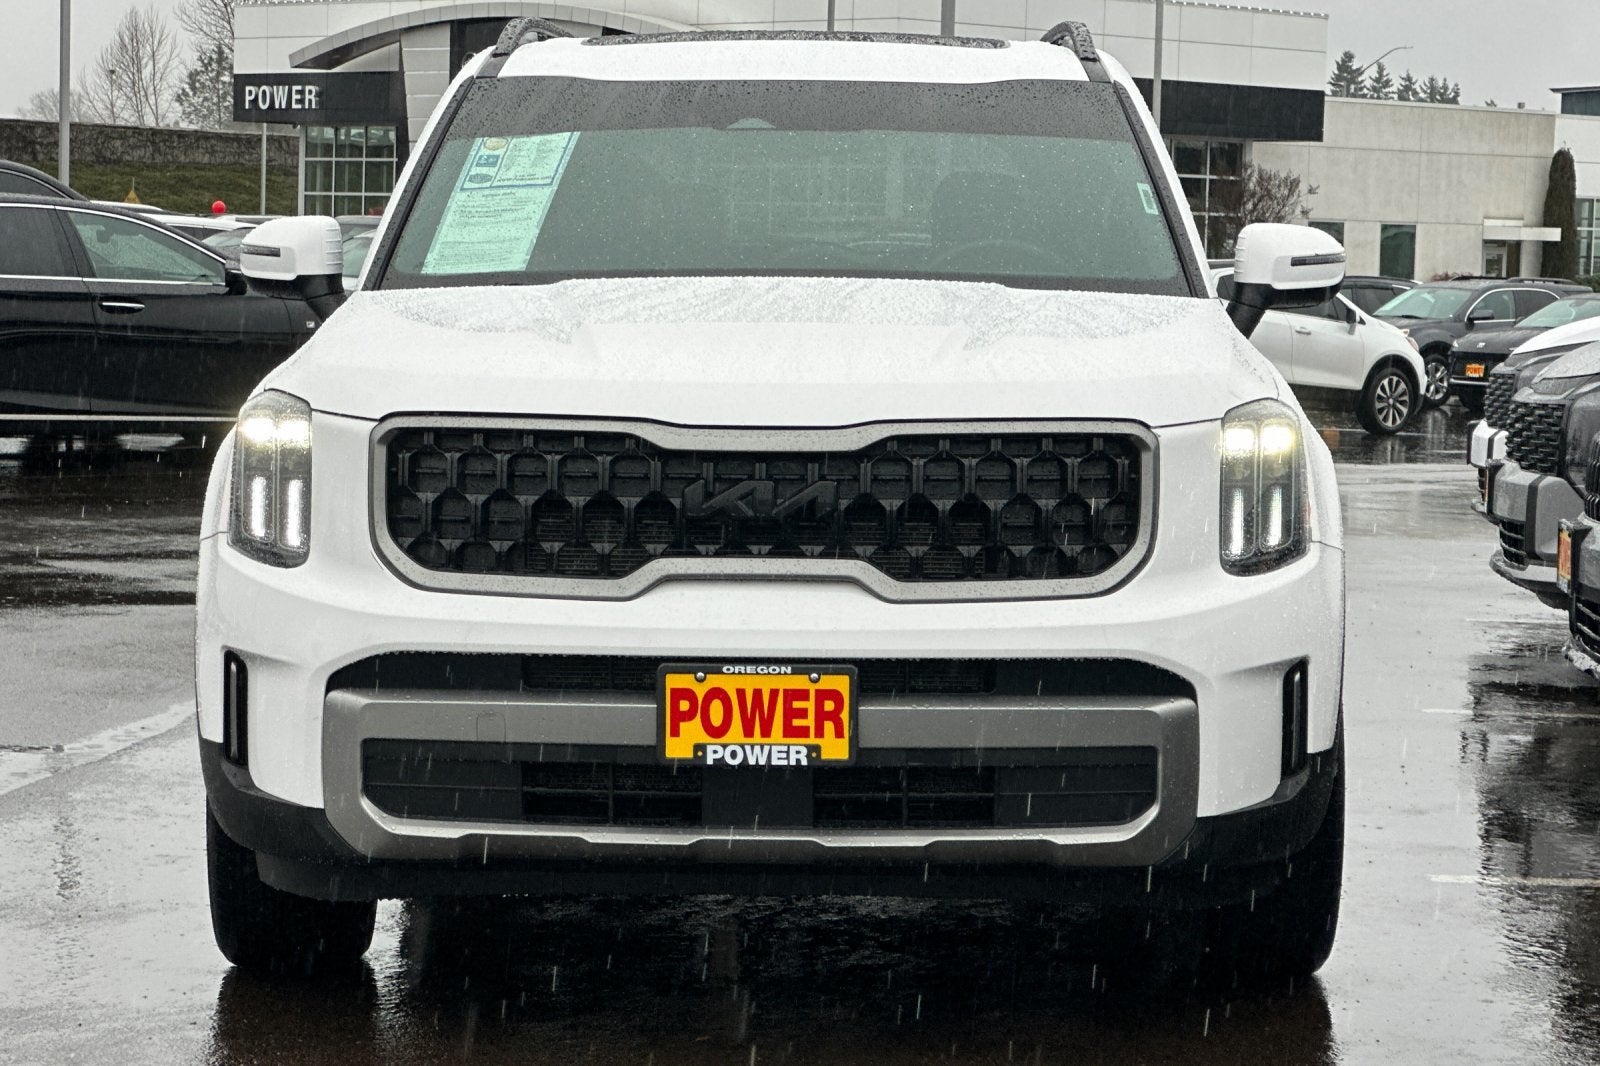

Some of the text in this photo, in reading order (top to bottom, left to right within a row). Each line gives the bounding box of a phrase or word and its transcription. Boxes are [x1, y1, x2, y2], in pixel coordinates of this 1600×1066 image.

[245, 85, 319, 110] POWER
[722, 665, 792, 675] OREGON
[669, 686, 845, 739] POWER
[706, 744, 808, 766] POWER
